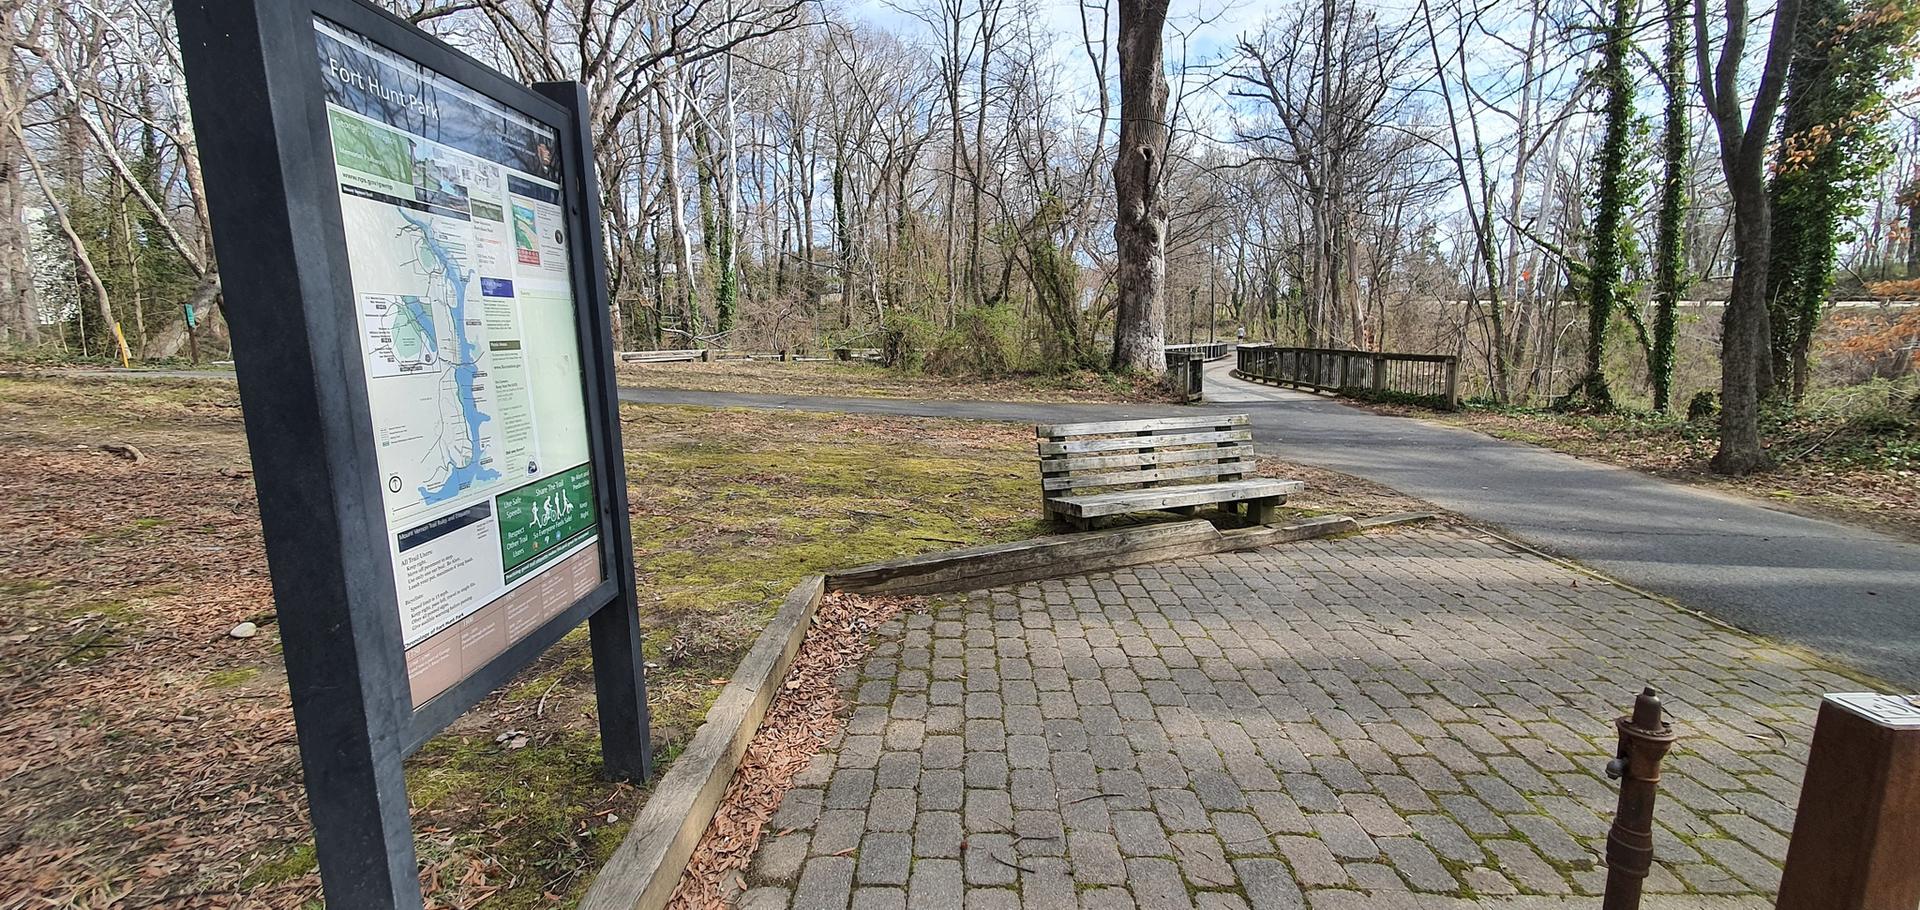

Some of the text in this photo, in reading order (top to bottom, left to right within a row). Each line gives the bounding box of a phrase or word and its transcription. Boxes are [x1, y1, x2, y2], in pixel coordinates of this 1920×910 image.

[329, 57, 439, 121] Fort Hunt Park
[536, 479, 564, 497] Share The Trail
[512, 496, 521, 505] Safe
[399, 531, 413, 540] Mount
[508, 527, 524, 539] Respect
[539, 525, 555, 536] Everyone
[507, 535, 528, 550] Other Trail
[513, 548, 524, 558] Users
